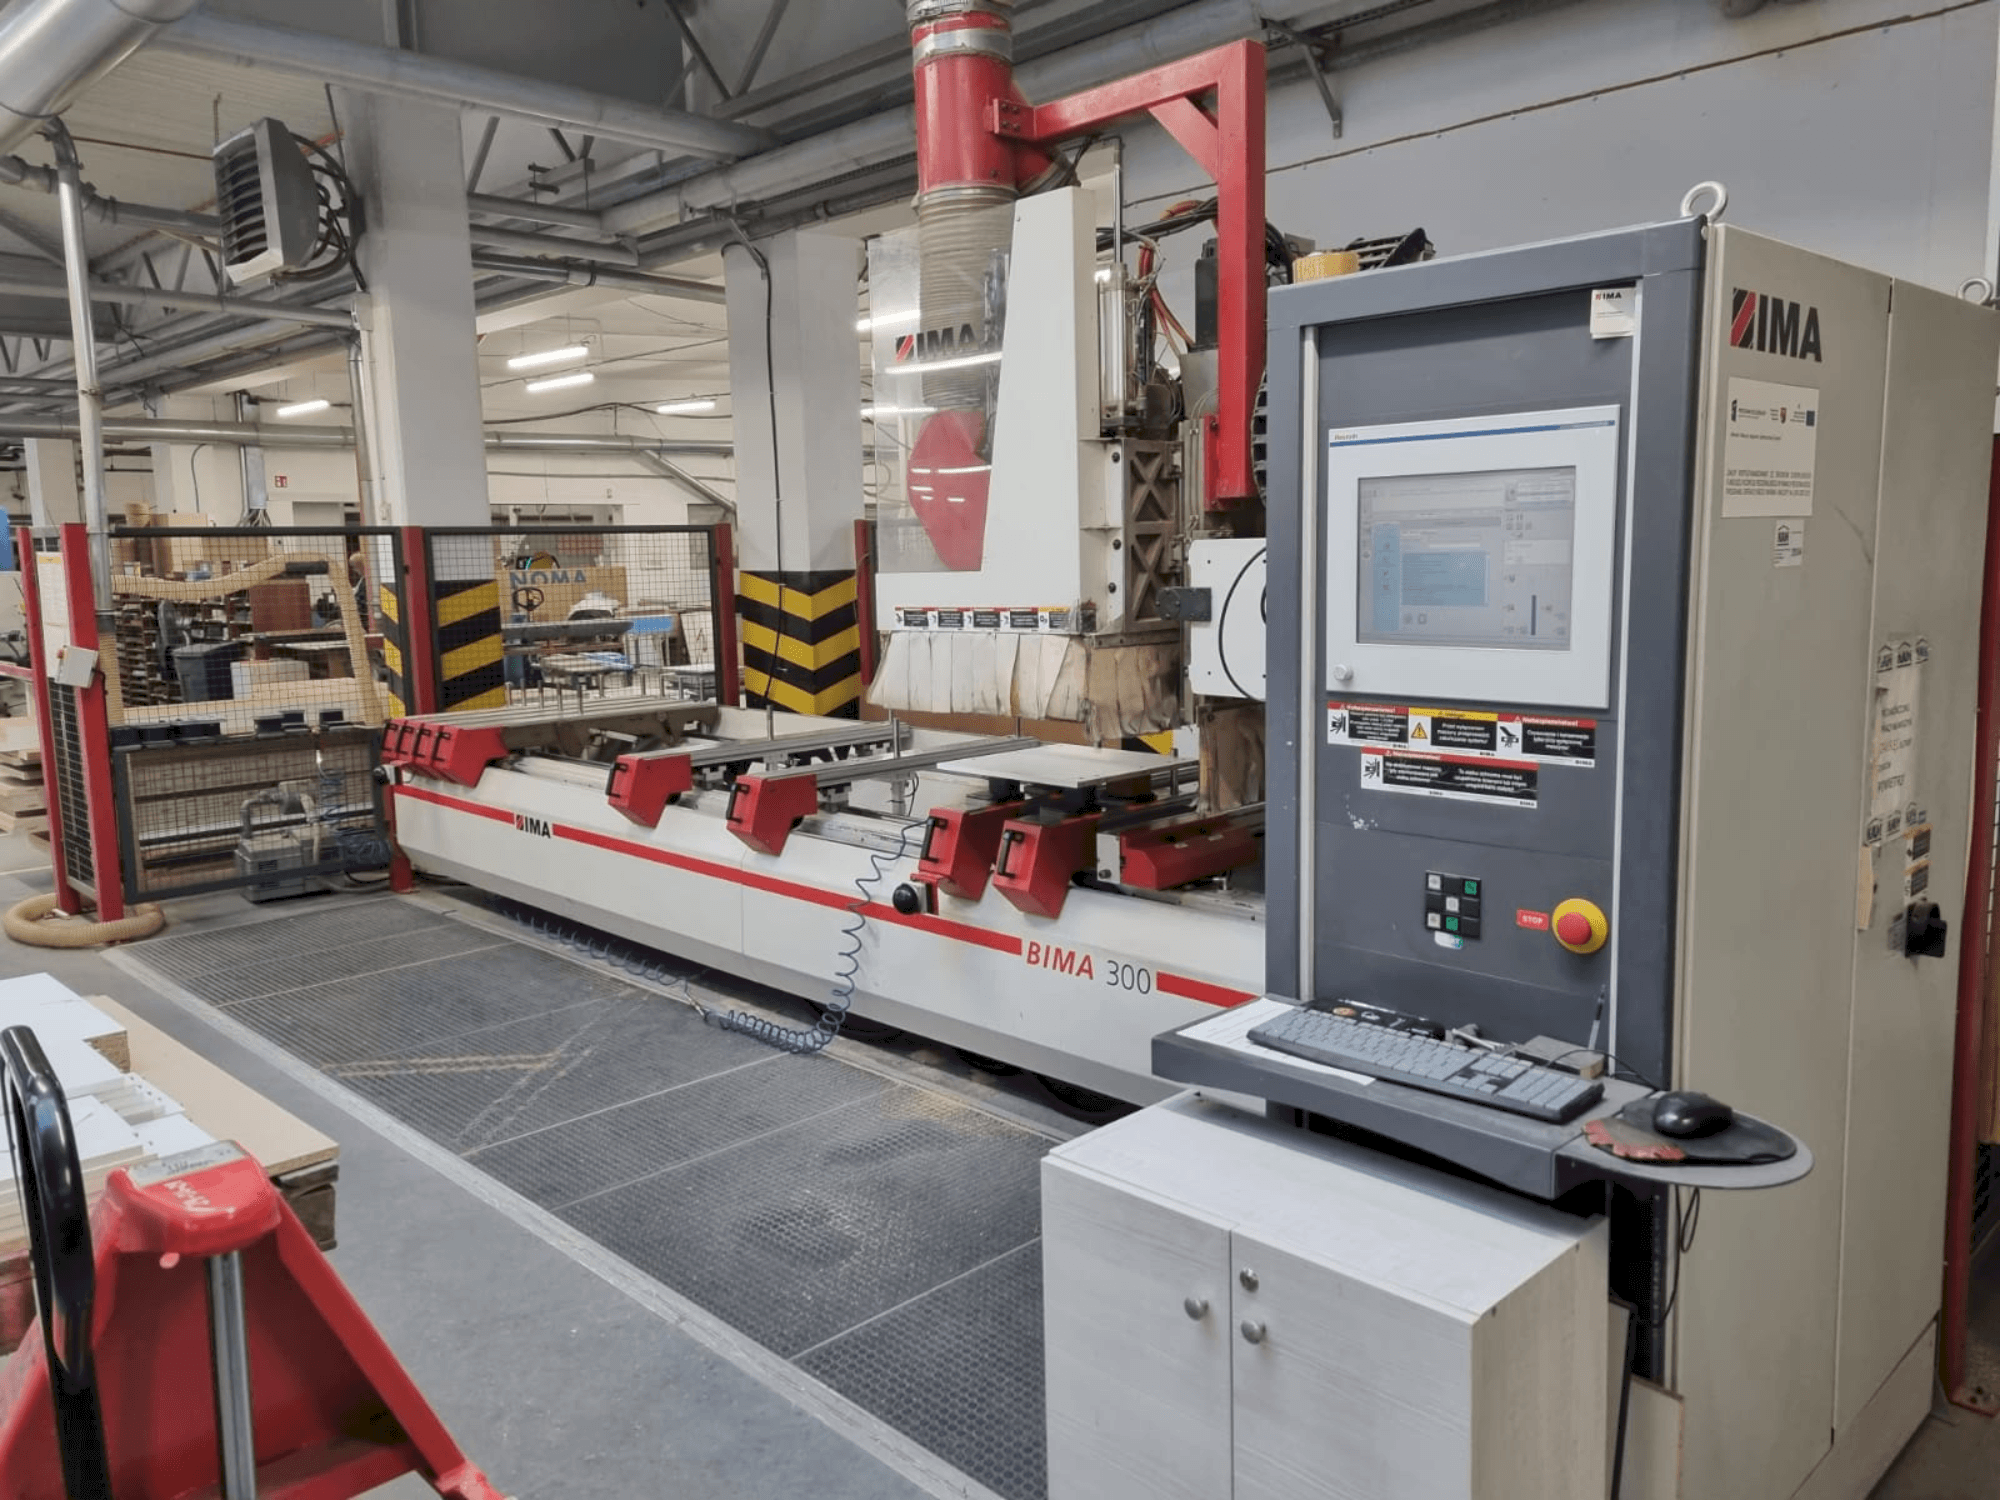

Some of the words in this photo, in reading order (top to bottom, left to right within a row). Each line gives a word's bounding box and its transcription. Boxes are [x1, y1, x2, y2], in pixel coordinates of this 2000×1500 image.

[916, 324, 977, 357] IMA
[1757, 293, 1823, 363] IMA
[525, 816, 551, 838] IMA
[1522, 915, 1544, 924] STOP
[1026, 941, 1093, 980] BIMA
[1106, 959, 1151, 994] 300
